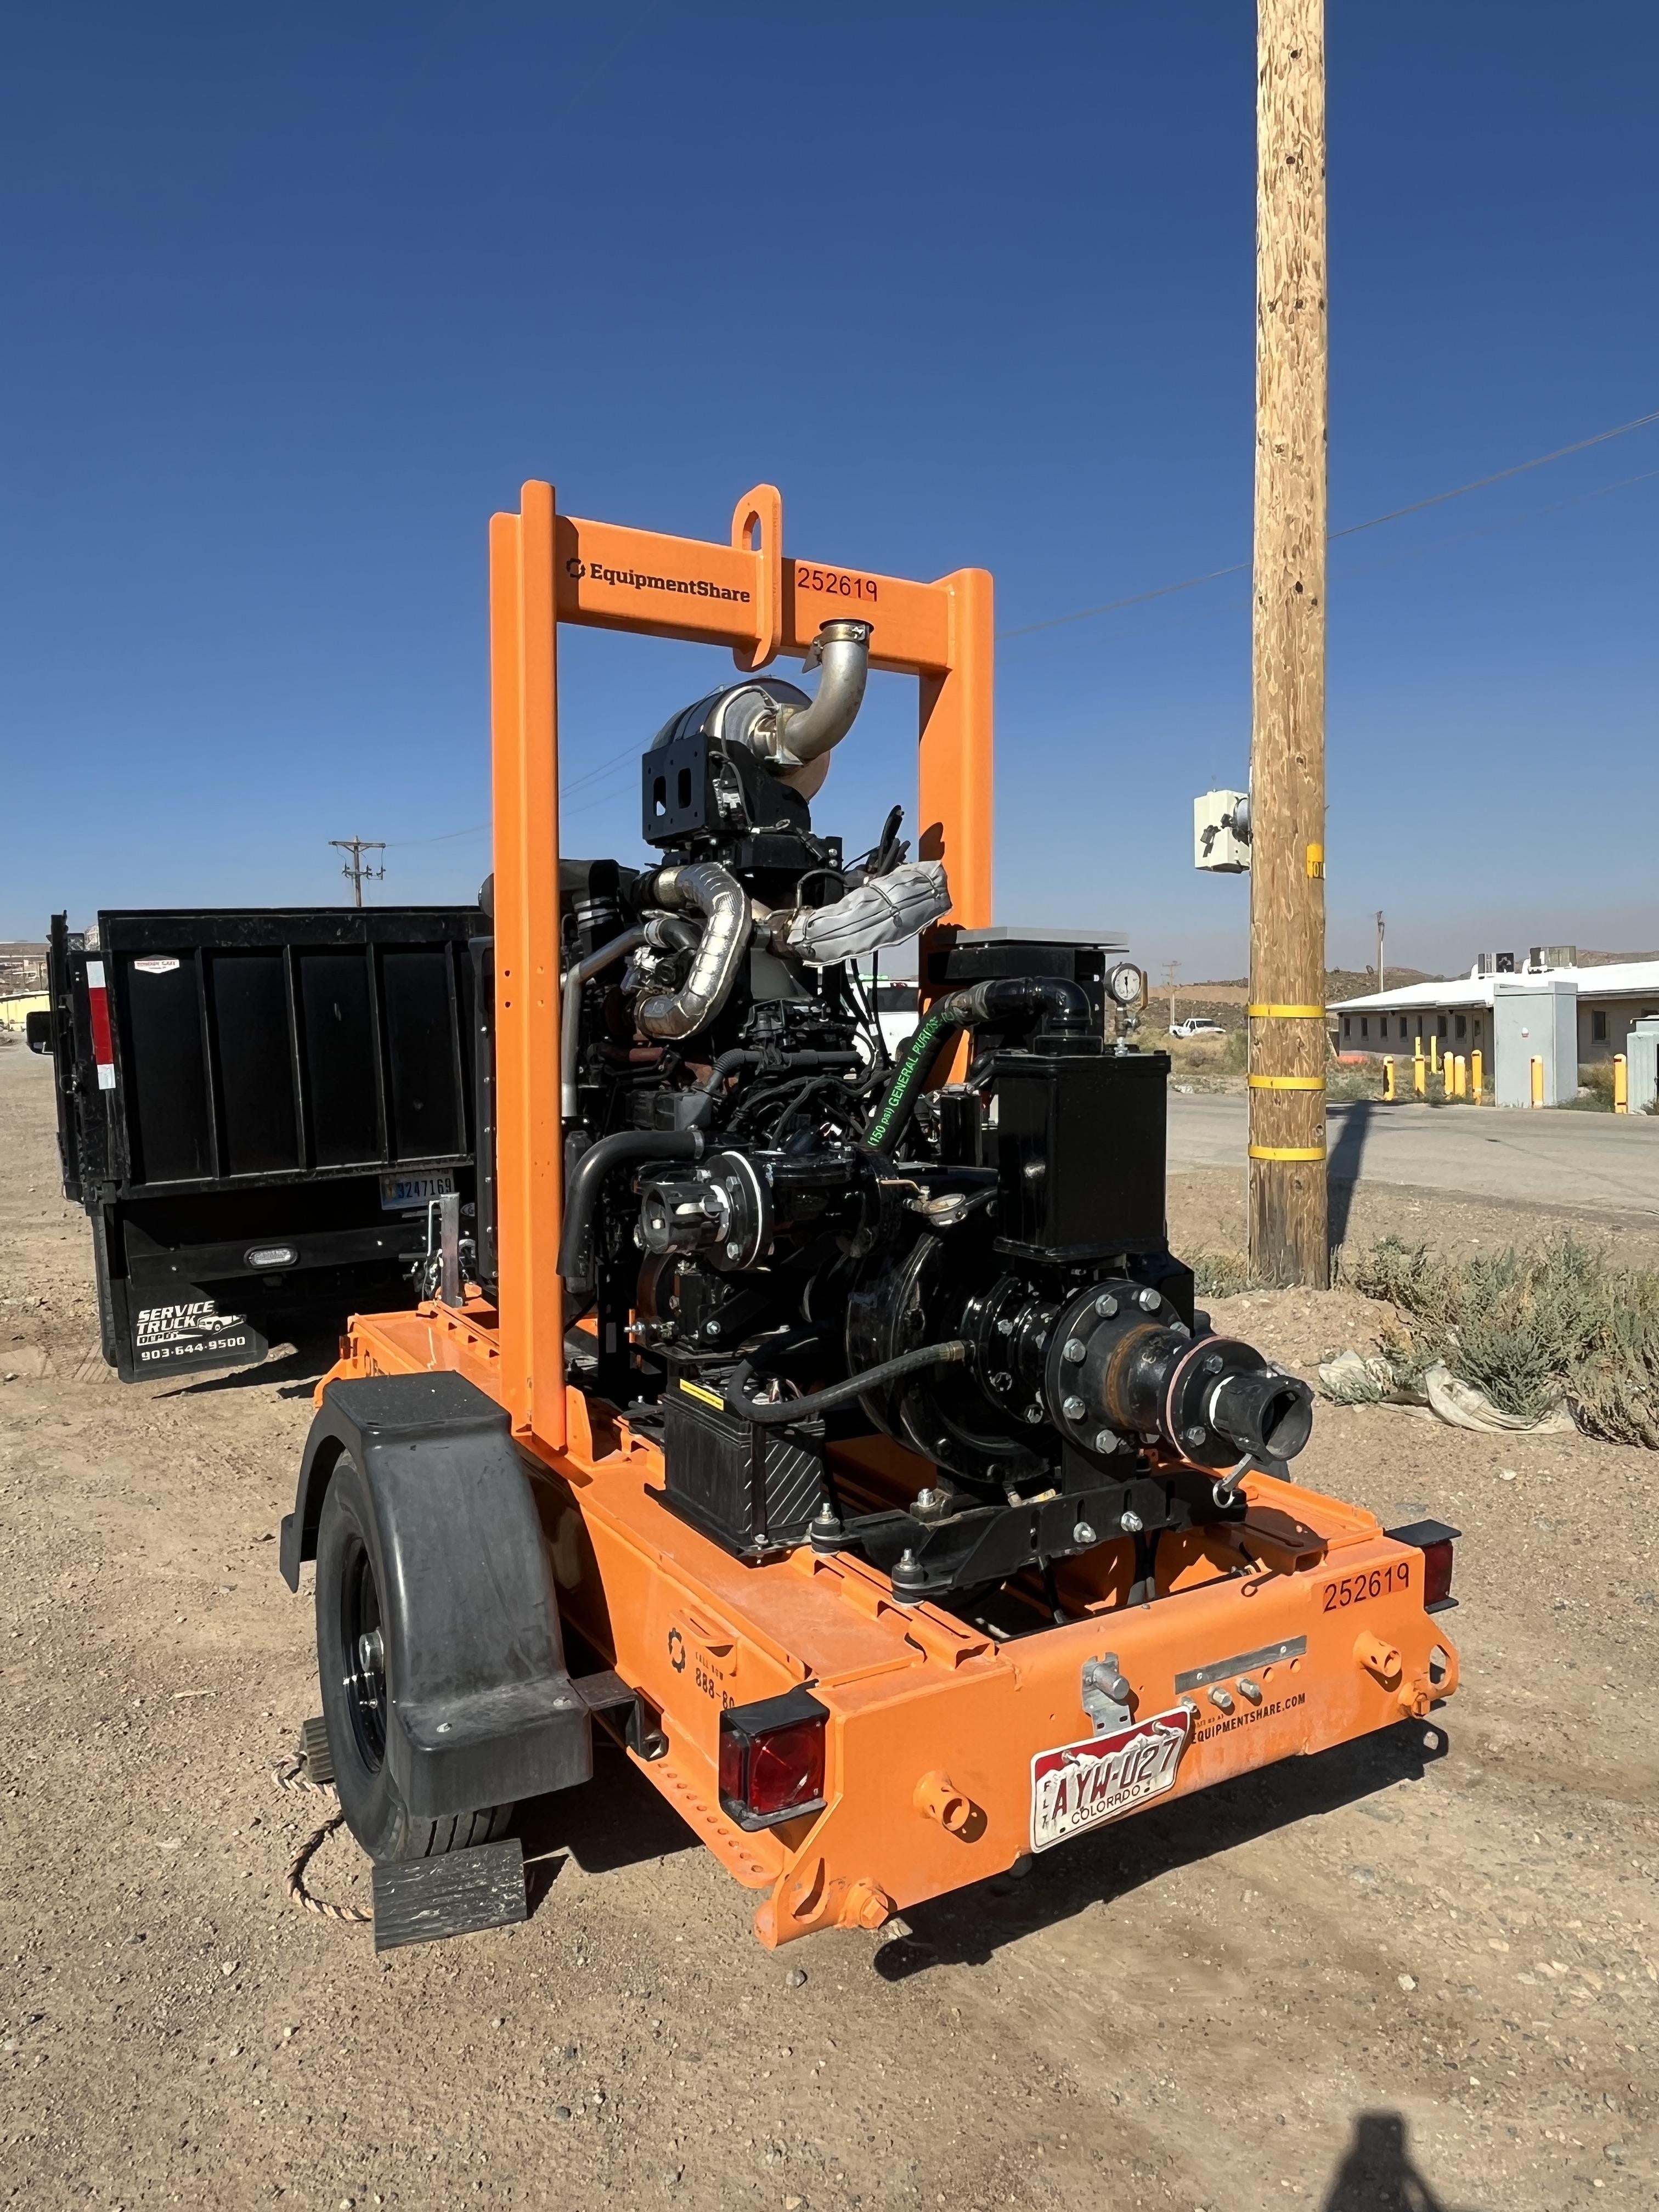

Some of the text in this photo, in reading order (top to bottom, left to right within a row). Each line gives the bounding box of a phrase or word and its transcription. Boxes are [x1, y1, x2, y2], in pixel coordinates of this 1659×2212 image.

[590, 563, 751, 603] EquipmentShare
[798, 567, 877, 602] 252619
[889, 1056, 919, 1107] GENERAL
[137, 1315, 198, 1335] TRUCK
[138, 1300, 215, 1323] SERVICE
[139, 1330, 180, 1345] DEPOT
[1323, 1562, 1409, 1615] 252619
[1051, 1735, 1181, 1820] AYW-U27
[1071, 1784, 1141, 1825] COLORADO
